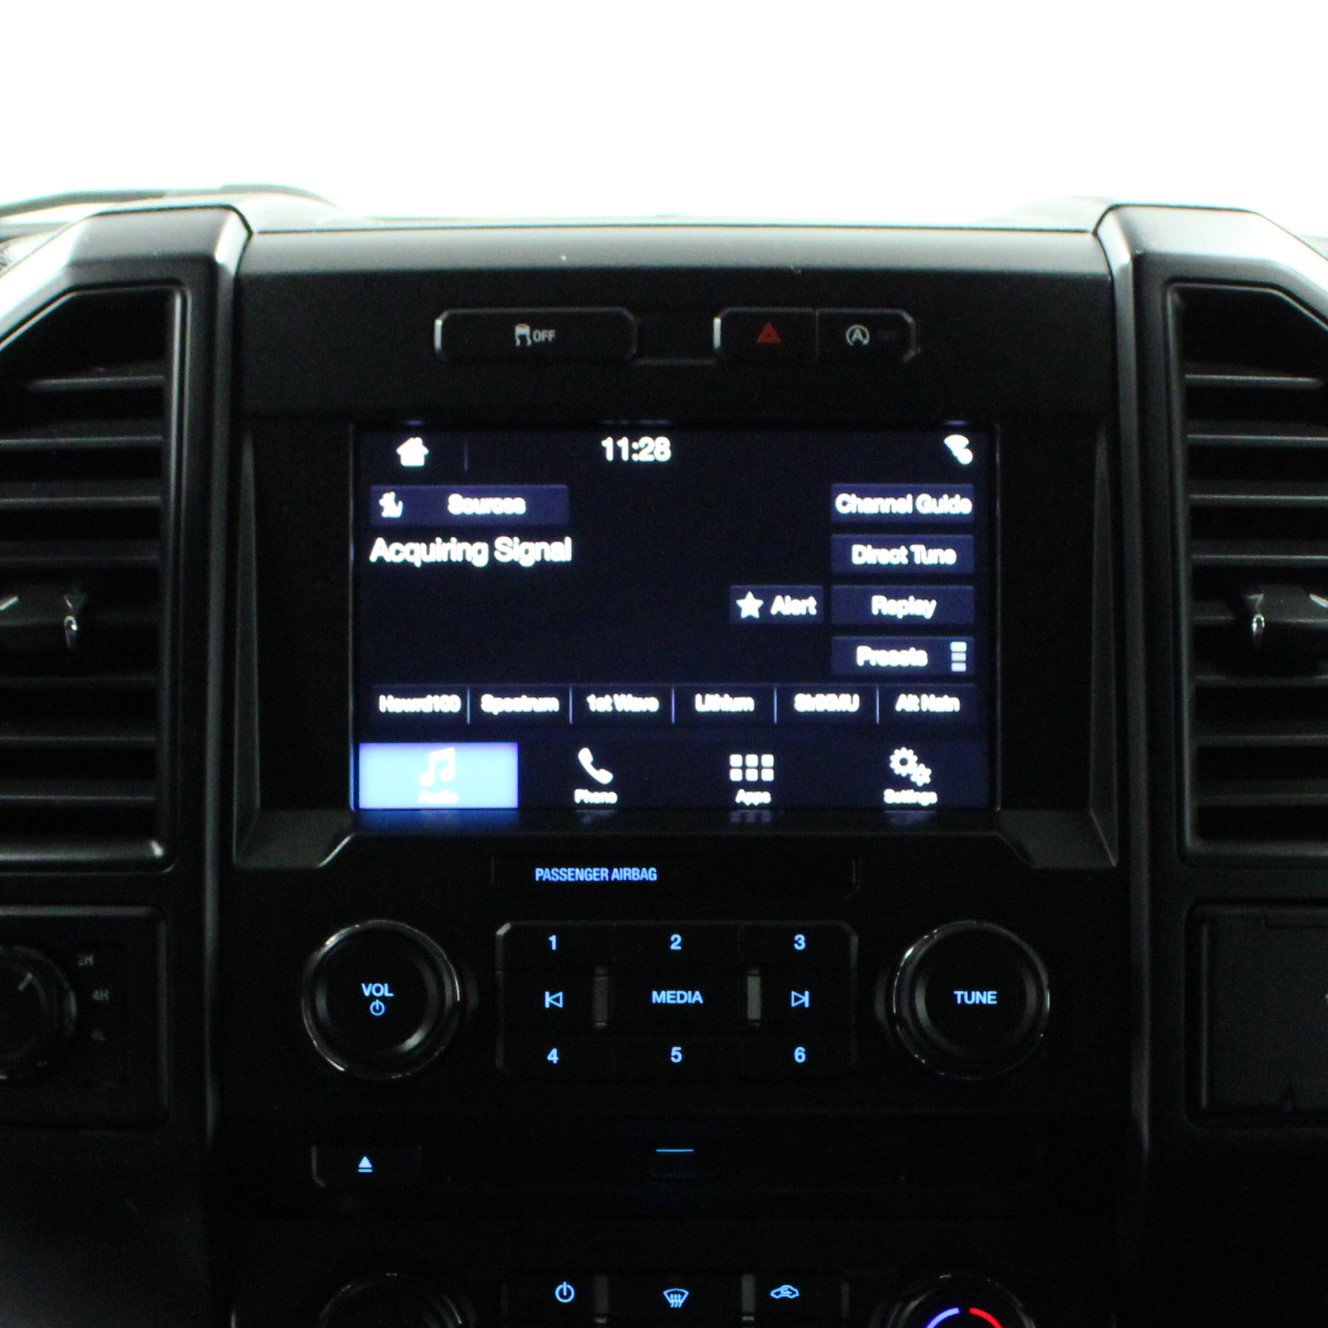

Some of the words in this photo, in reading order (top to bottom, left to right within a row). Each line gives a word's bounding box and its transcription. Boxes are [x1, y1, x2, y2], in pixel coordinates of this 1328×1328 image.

[533, 329, 556, 343] OFF
[601, 436, 672, 463] 11:28
[447, 493, 527, 516] Sources
[834, 493, 913, 516] Channel
[914, 493, 973, 516] Guide
[369, 536, 489, 568] Acquiring
[493, 535, 573, 568] Signal
[851, 544, 909, 566] Direct
[910, 544, 957, 566] Tune
[770, 595, 818, 616] Alert
[871, 595, 937, 620] Replay
[856, 645, 929, 668] Presets
[480, 693, 560, 716] Spectrum
[586, 693, 613, 713] 1st
[613, 693, 660, 713] Wave
[694, 693, 755, 713] Lithium
[574, 788, 618, 804] Phone
[734, 788, 772, 806] Apps
[535, 867, 607, 882] PASSENGER
[610, 867, 658, 882] AIRBAG
[548, 934, 557, 951] 1
[670, 933, 682, 951] 2
[793, 933, 806, 951] 3
[361, 983, 394, 997] VOL
[651, 990, 704, 1004] MEDIA
[954, 990, 998, 1005] TUNE
[546, 1047, 560, 1064] 4
[670, 1046, 683, 1063] 5
[793, 1046, 807, 1064] 6
